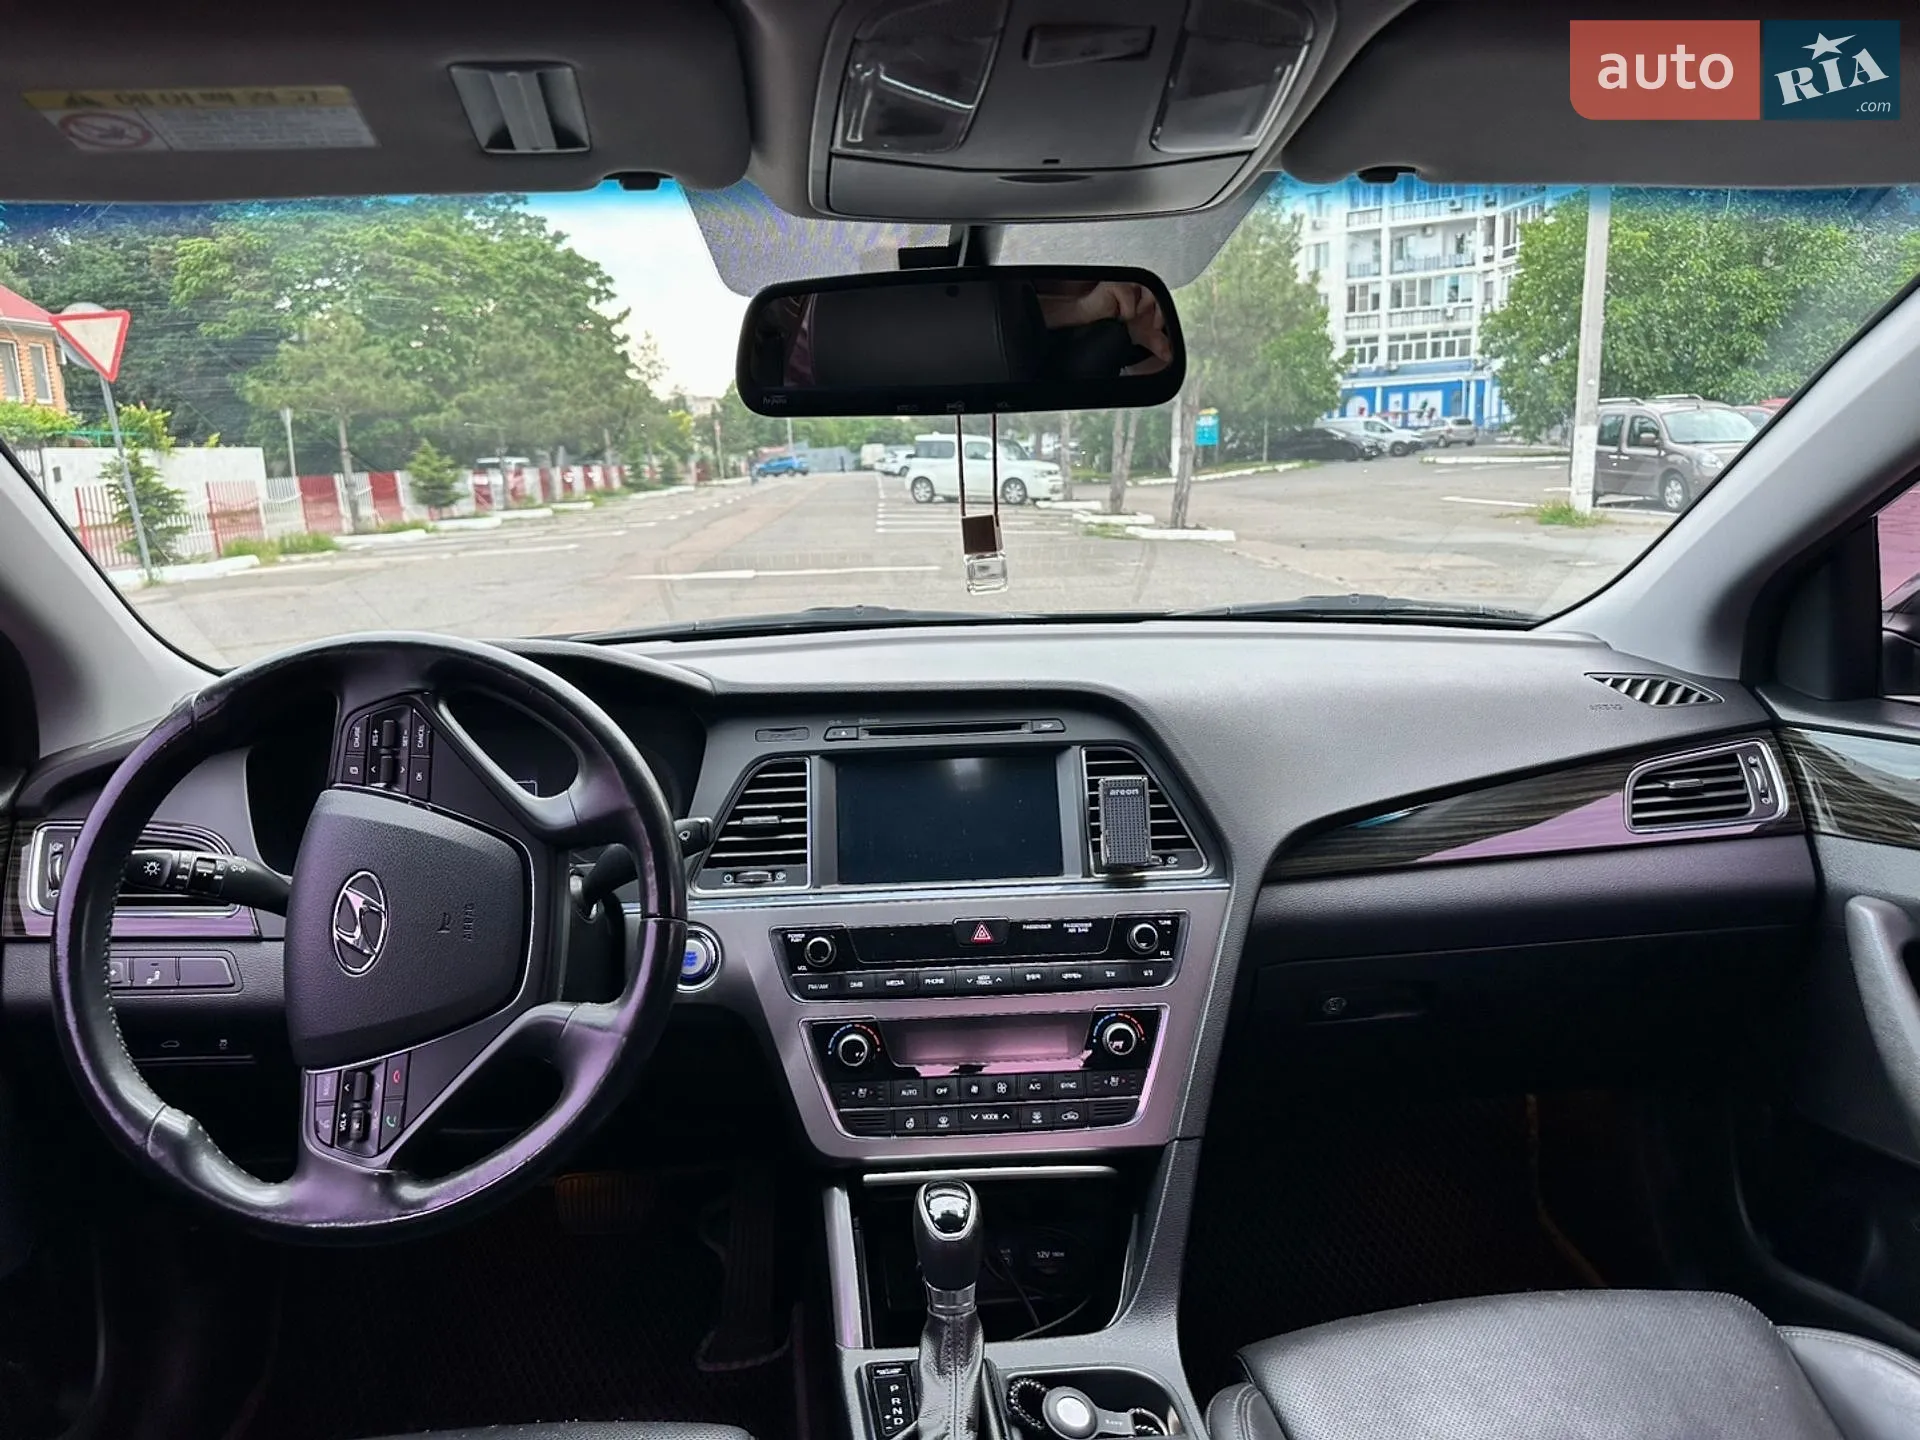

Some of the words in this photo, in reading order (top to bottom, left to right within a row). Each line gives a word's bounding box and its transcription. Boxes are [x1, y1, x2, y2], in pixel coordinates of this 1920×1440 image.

[417, 724, 426, 748] CANCEL
[1109, 788, 1139, 796] areon
[885, 979, 905, 987] MEDIA
[1028, 1082, 1042, 1090] A/C
[936, 1087, 948, 1095] OFF
[1036, 1250, 1050, 1258] 12V
[889, 1384, 900, 1392] P
[891, 1397, 902, 1405] R
[892, 1406, 903, 1415] N
[893, 1417, 904, 1425] D
